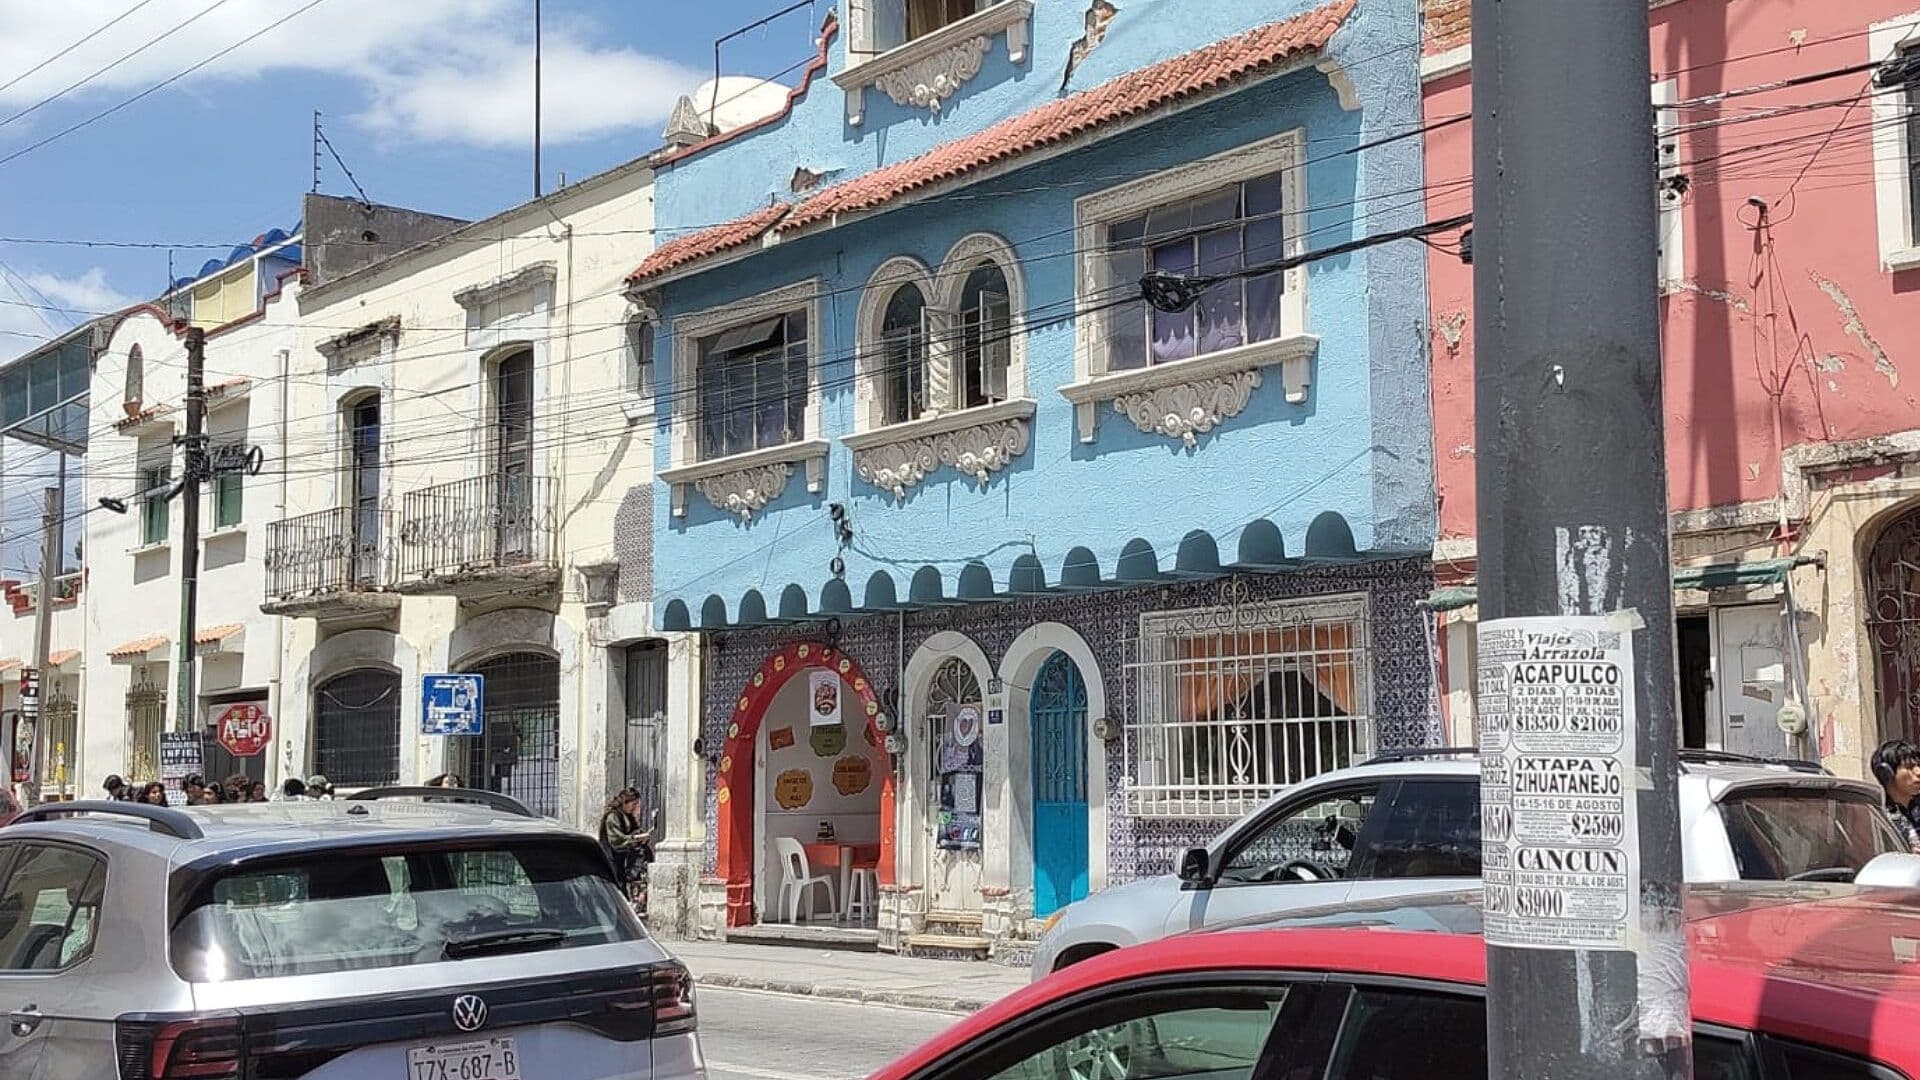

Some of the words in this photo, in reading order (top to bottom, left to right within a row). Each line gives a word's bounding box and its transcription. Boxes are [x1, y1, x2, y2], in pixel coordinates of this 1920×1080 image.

[1528, 632, 1572, 647] Viajes
[1529, 646, 1605, 660] Arrazola
[1514, 665, 1618, 684] ACAPULCO
[1517, 687, 1524, 696] 2
[1528, 687, 1556, 696] DIAS
[1585, 687, 1616, 696] DIAS
[1516, 715, 1559, 731] $1350
[1570, 715, 1618, 732] $2100
[162, 748, 200, 758] INFIEL
[1517, 758, 1594, 771] IXTAPA
[1602, 759, 1616, 772] Y
[1515, 773, 1620, 795] ZIHUATANEJO
[1515, 798, 1554, 810] 14-15-16
[1558, 799, 1571, 810] DE
[1575, 799, 1620, 811] AGOSTO
[1571, 813, 1621, 836] $2590
[1518, 848, 1619, 873] CANCUN
[1516, 888, 1563, 918] $3900
